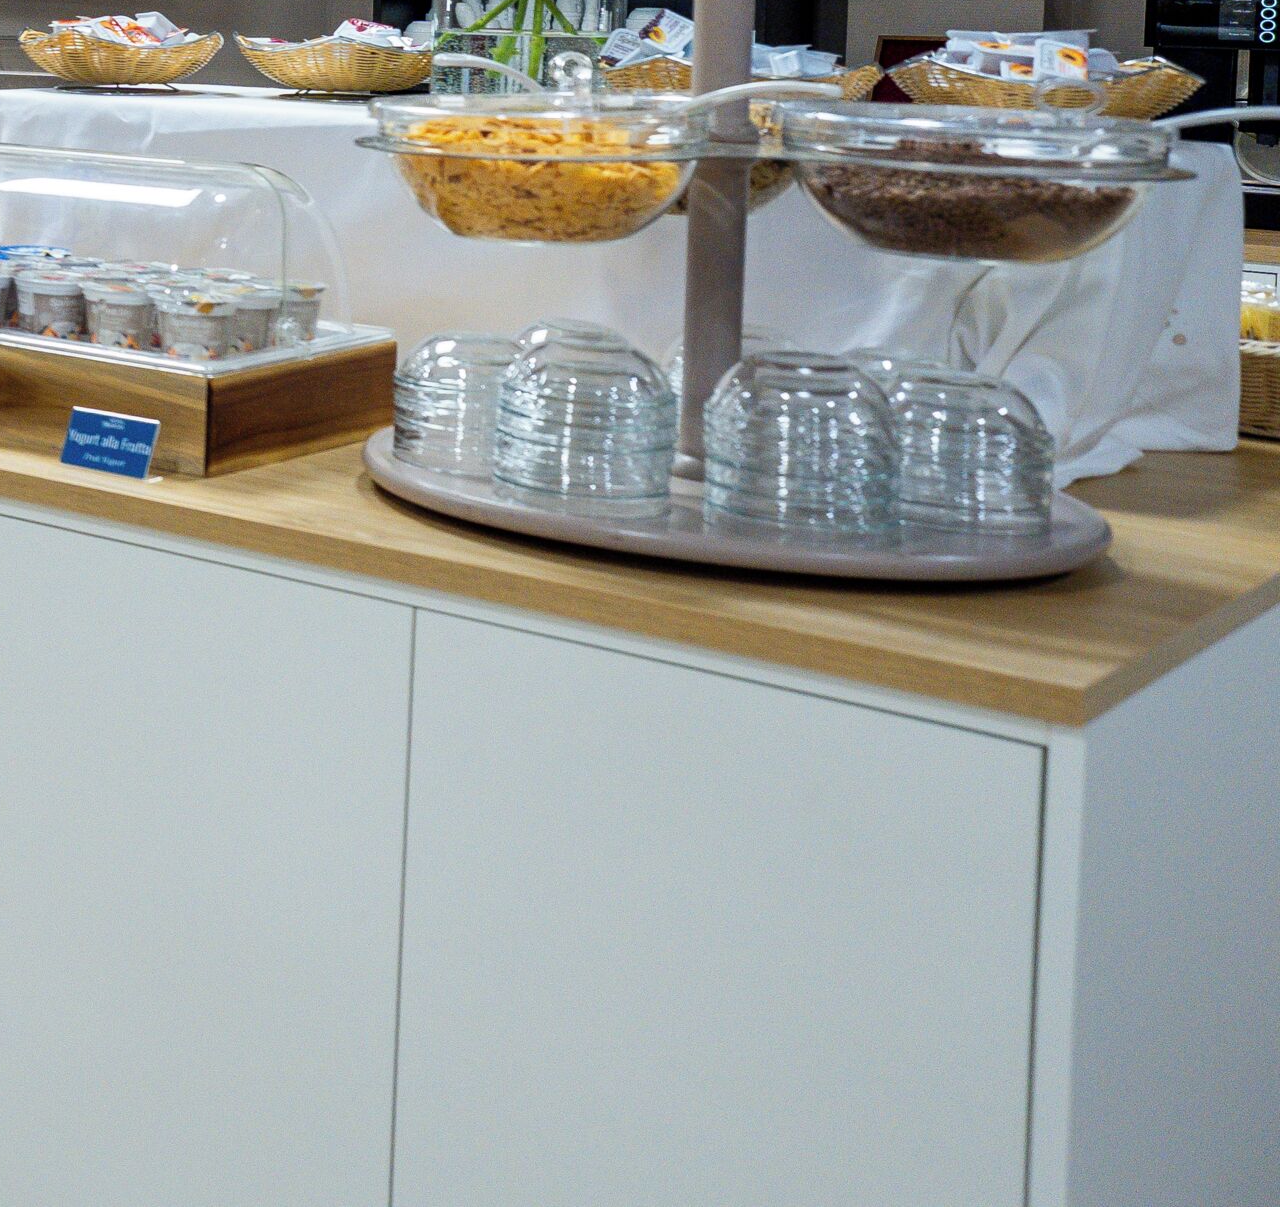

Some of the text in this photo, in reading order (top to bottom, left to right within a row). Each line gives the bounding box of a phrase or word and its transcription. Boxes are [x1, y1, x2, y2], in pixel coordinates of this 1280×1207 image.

[68, 427, 152, 456] Yogurt alla Frutta
